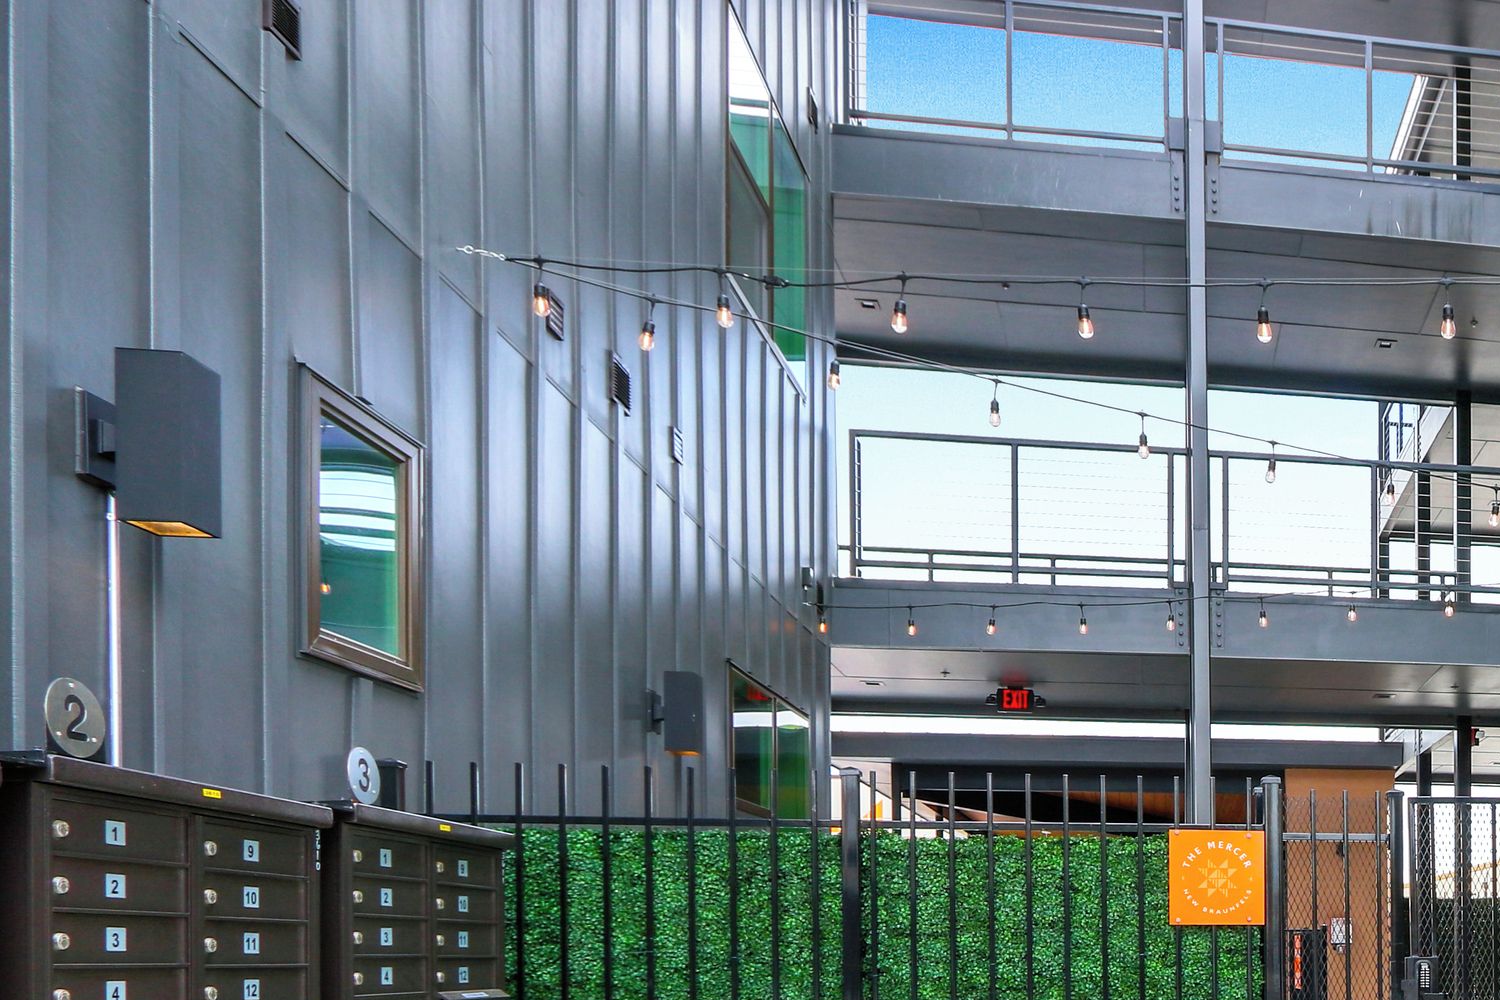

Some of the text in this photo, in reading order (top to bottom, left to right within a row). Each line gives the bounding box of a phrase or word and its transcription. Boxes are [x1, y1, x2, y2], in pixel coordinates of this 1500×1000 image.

[1002, 690, 1029, 709] EXIT
[64, 694, 88, 742] 2
[358, 758, 370, 792] 3
[111, 826, 118, 842] 1
[248, 845, 254, 858] 9
[1182, 840, 1252, 868] THE MERCER
[111, 879, 119, 894] 2
[245, 891, 257, 905] 10
[1183, 888, 1252, 914] NEW BRAUNFELS
[112, 932, 120, 948] 3
[246, 937, 256, 950] 11
[111, 986, 120, 1000] 4
[246, 984, 257, 997] 12
